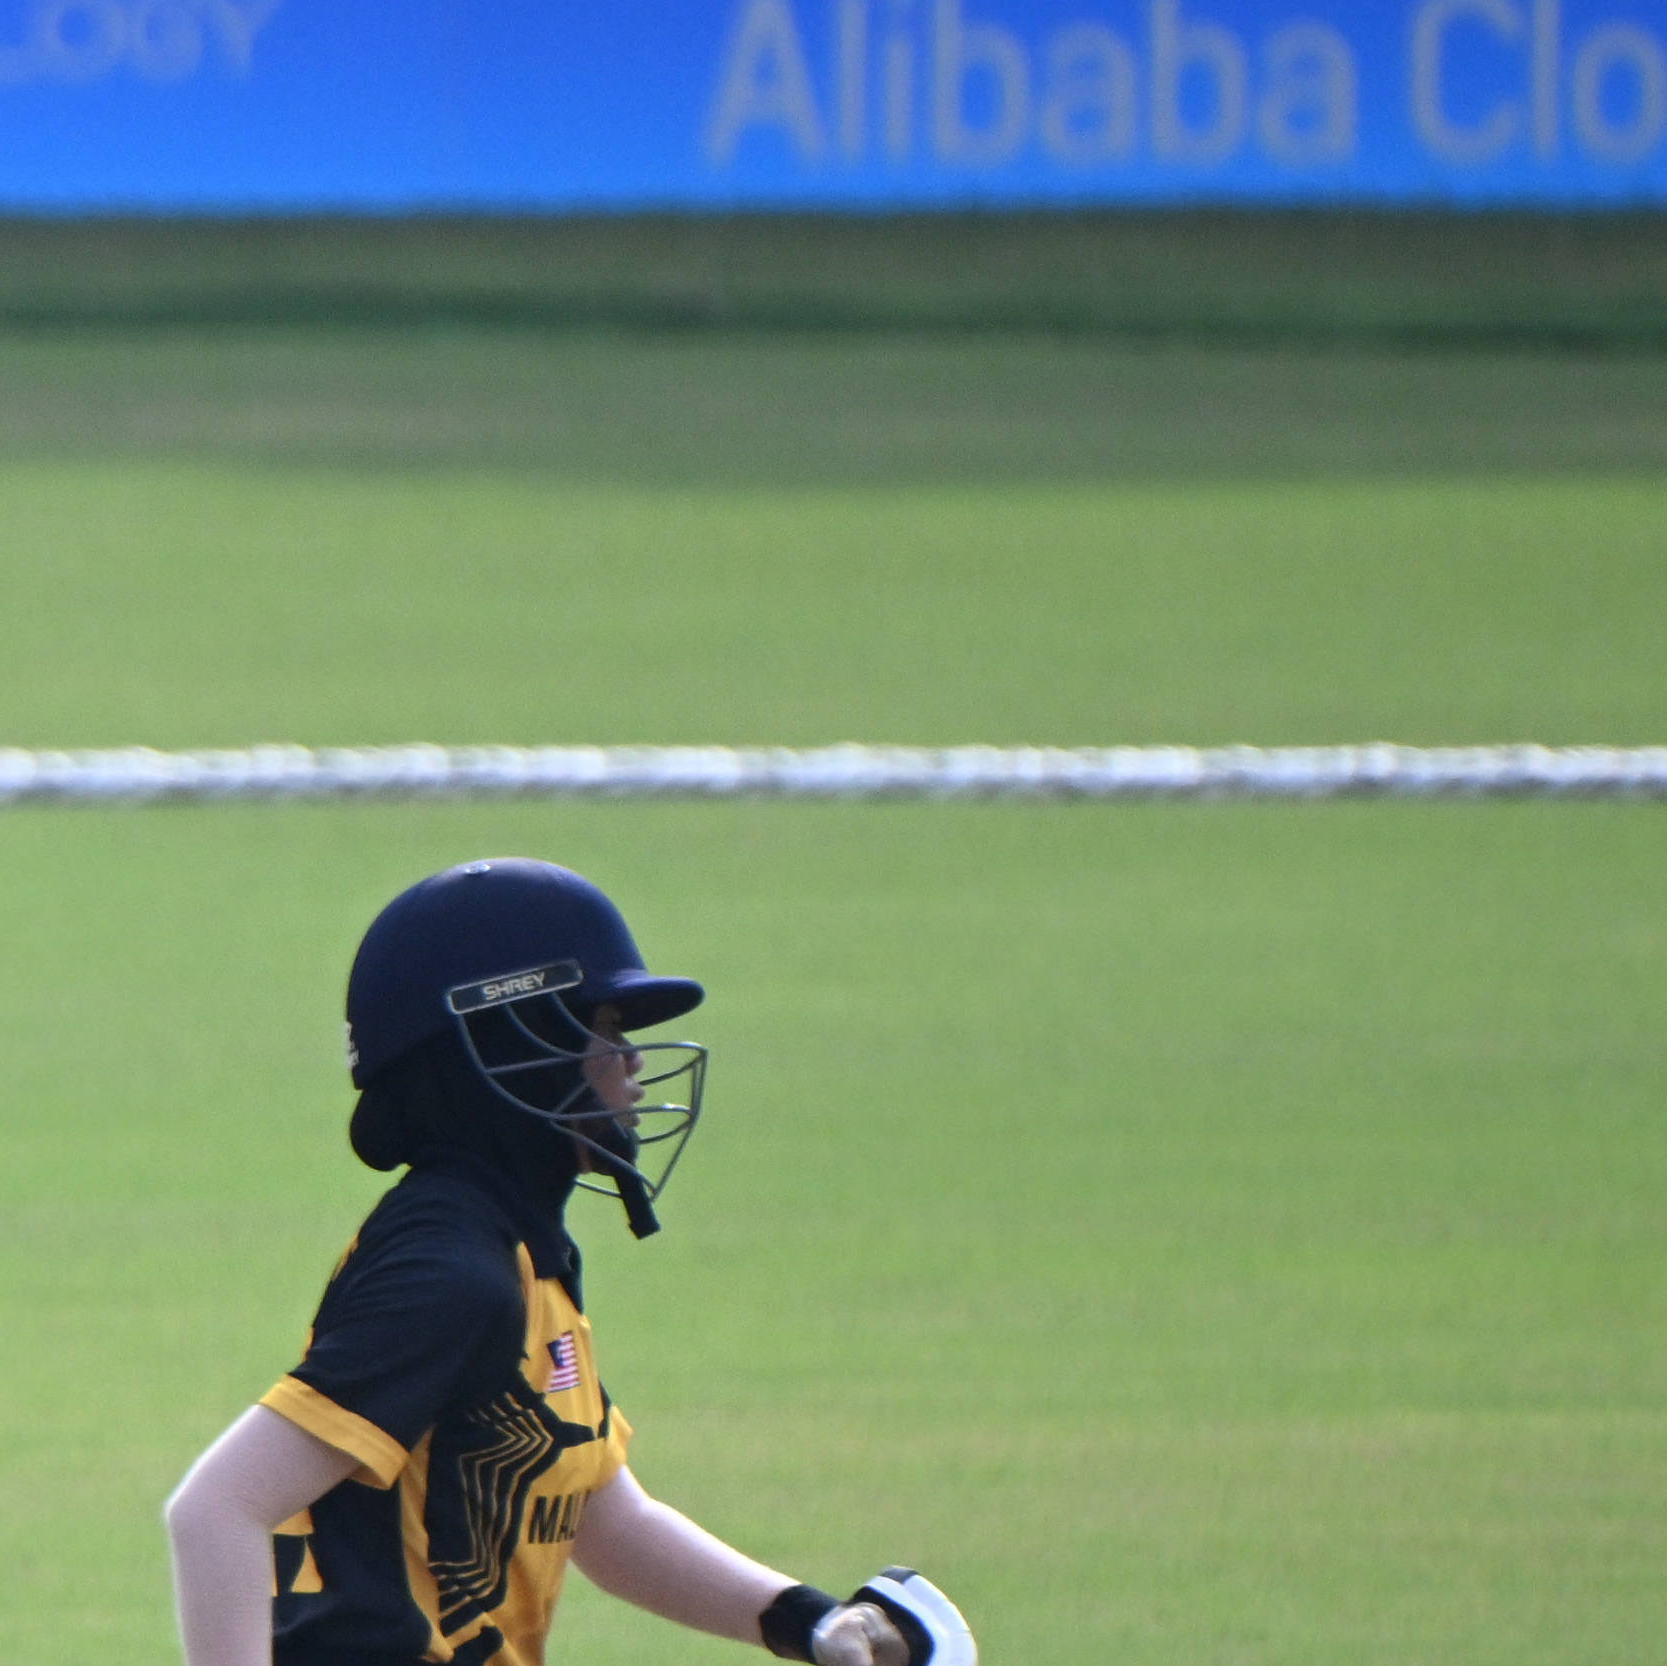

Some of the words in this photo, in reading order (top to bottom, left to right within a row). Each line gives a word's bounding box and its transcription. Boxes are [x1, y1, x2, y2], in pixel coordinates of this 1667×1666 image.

[703, 0, 1359, 170] Alibaba
[1407, 0, 1667, 168] Clo
[483, 971, 545, 1001] SHREY
